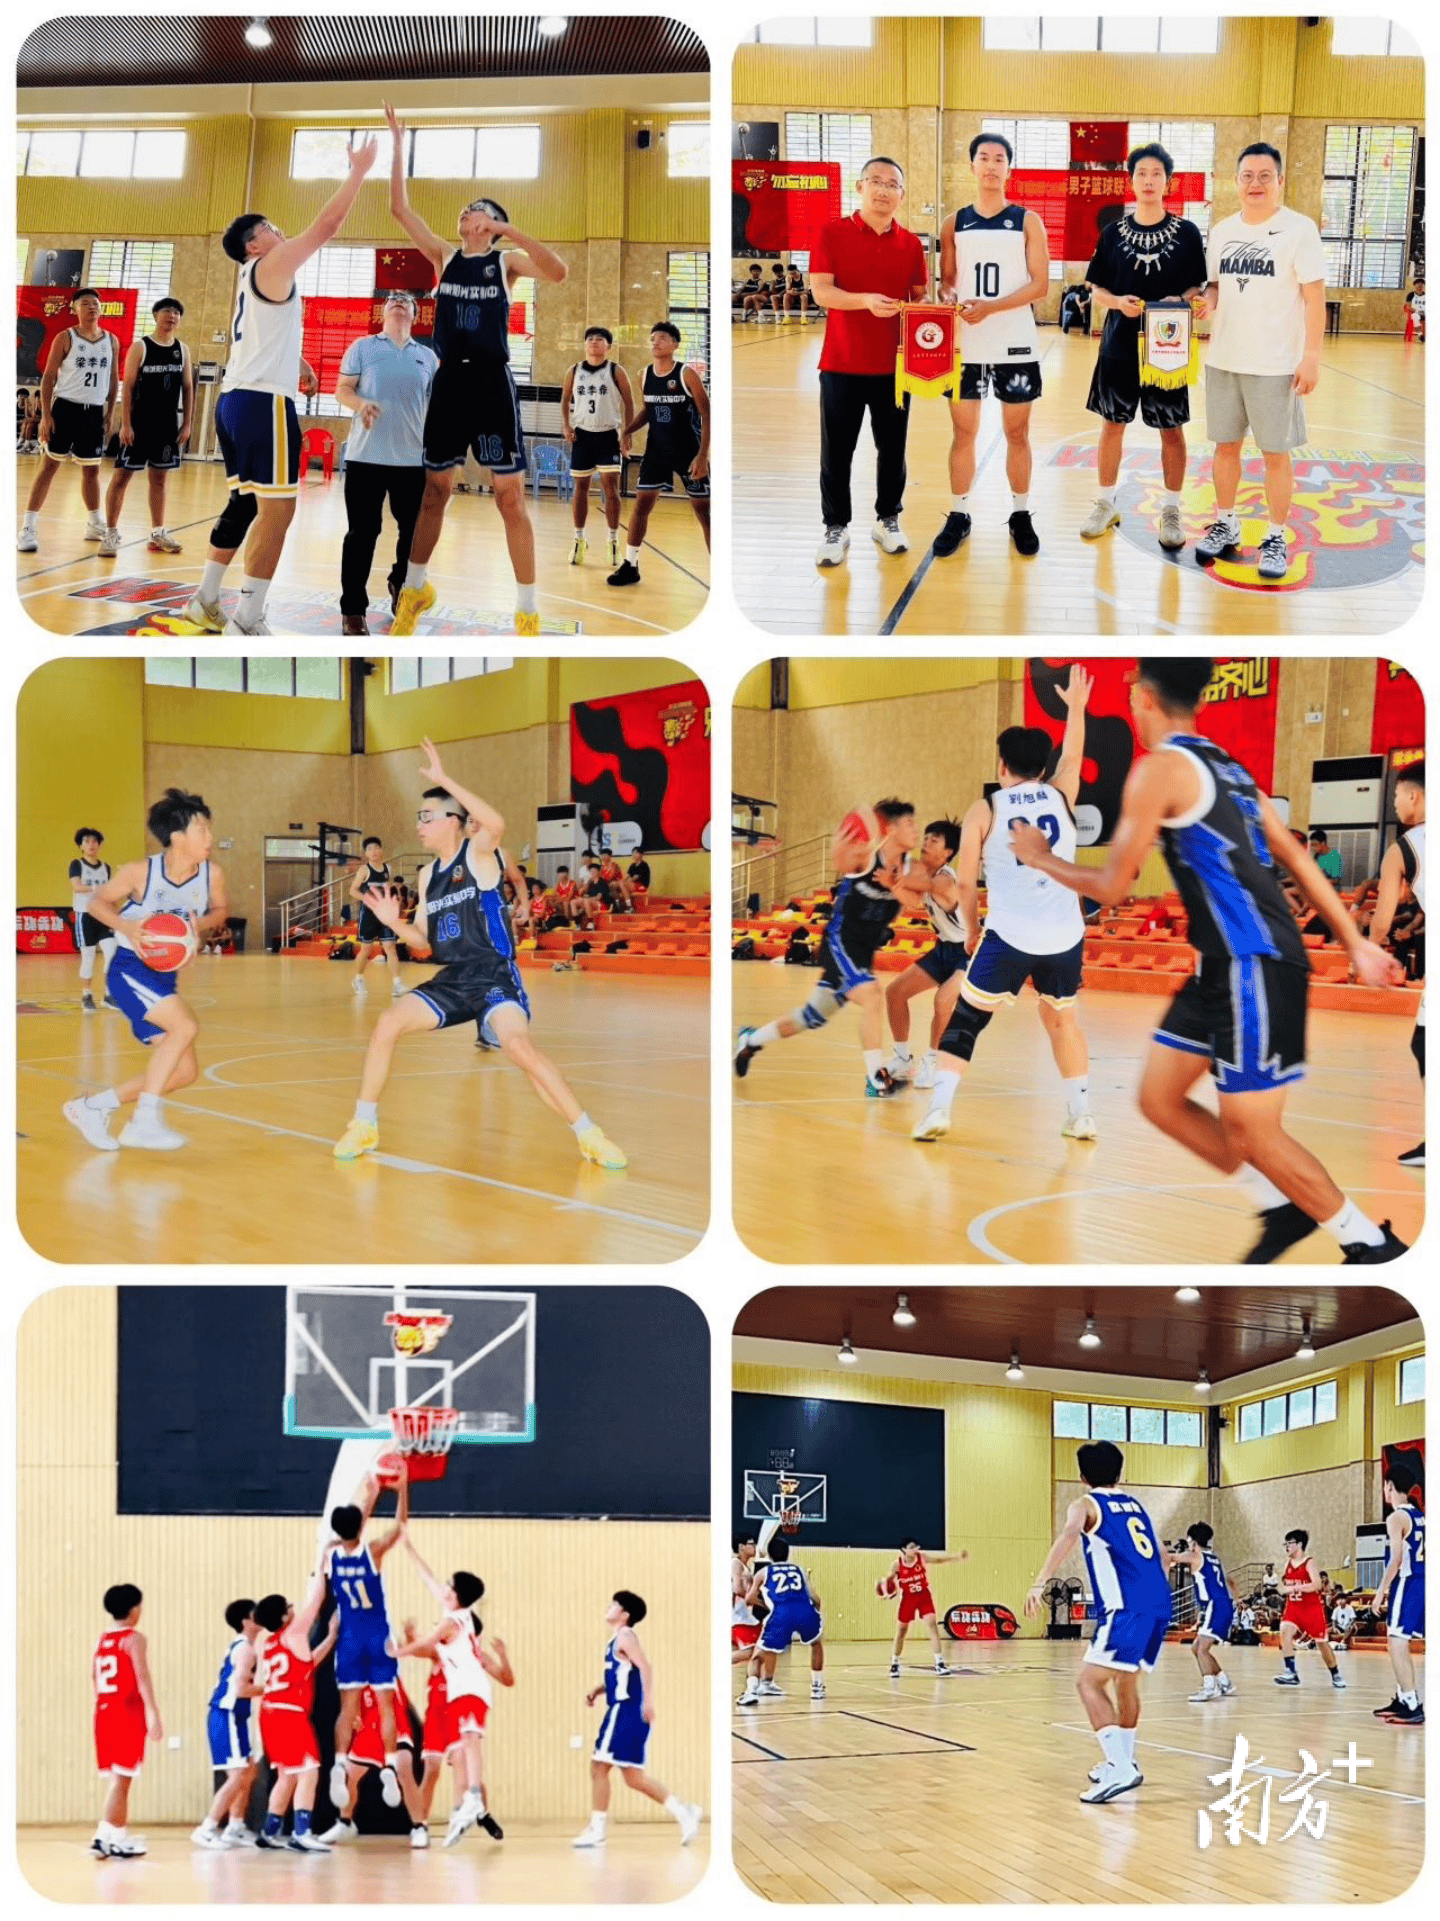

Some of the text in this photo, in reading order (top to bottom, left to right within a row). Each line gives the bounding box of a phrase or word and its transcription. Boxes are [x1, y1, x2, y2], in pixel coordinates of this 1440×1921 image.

[1219, 259, 1275, 277] MAMBA
[975, 262, 1000, 297] 10
[84, 371, 98, 388] 21
[588, 399, 597, 415] 3
[655, 405, 672, 423] 13
[477, 433, 504, 461] 16
[437, 911, 461, 942] 16
[1126, 1516, 1154, 1560] 6
[772, 1572, 803, 1594] 23
[908, 1581, 923, 1594] 26
[340, 1579, 374, 1610] 11
